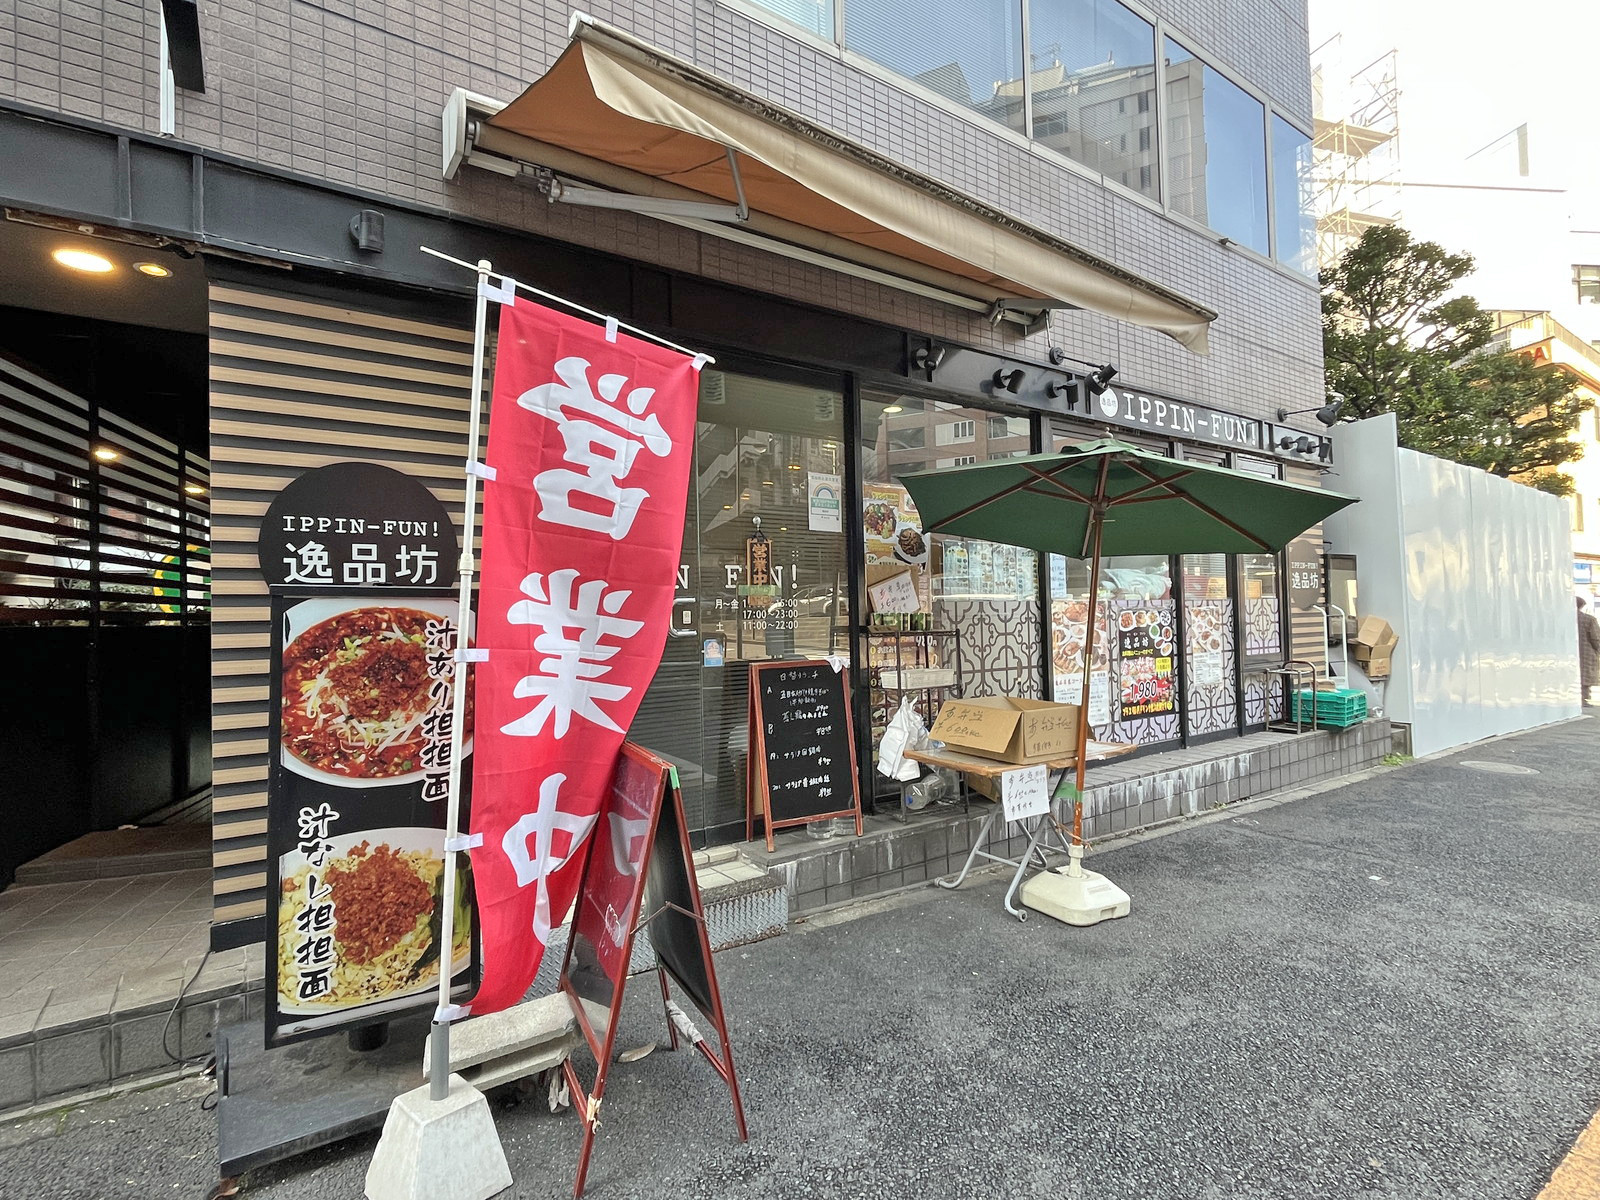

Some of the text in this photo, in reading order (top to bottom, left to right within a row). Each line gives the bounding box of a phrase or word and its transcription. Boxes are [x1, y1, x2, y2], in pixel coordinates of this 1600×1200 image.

[1122, 392, 1257, 446] IPPIN-FUN!
[282, 515, 440, 537] IPPIN-FUN!
[283, 540, 439, 584] 逸品坊
[752, 543, 767, 586] 営業中
[1292, 571, 1319, 589] 逸品坊
[715, 621, 725, 632] 土
[500, 356, 673, 947] 営業中
